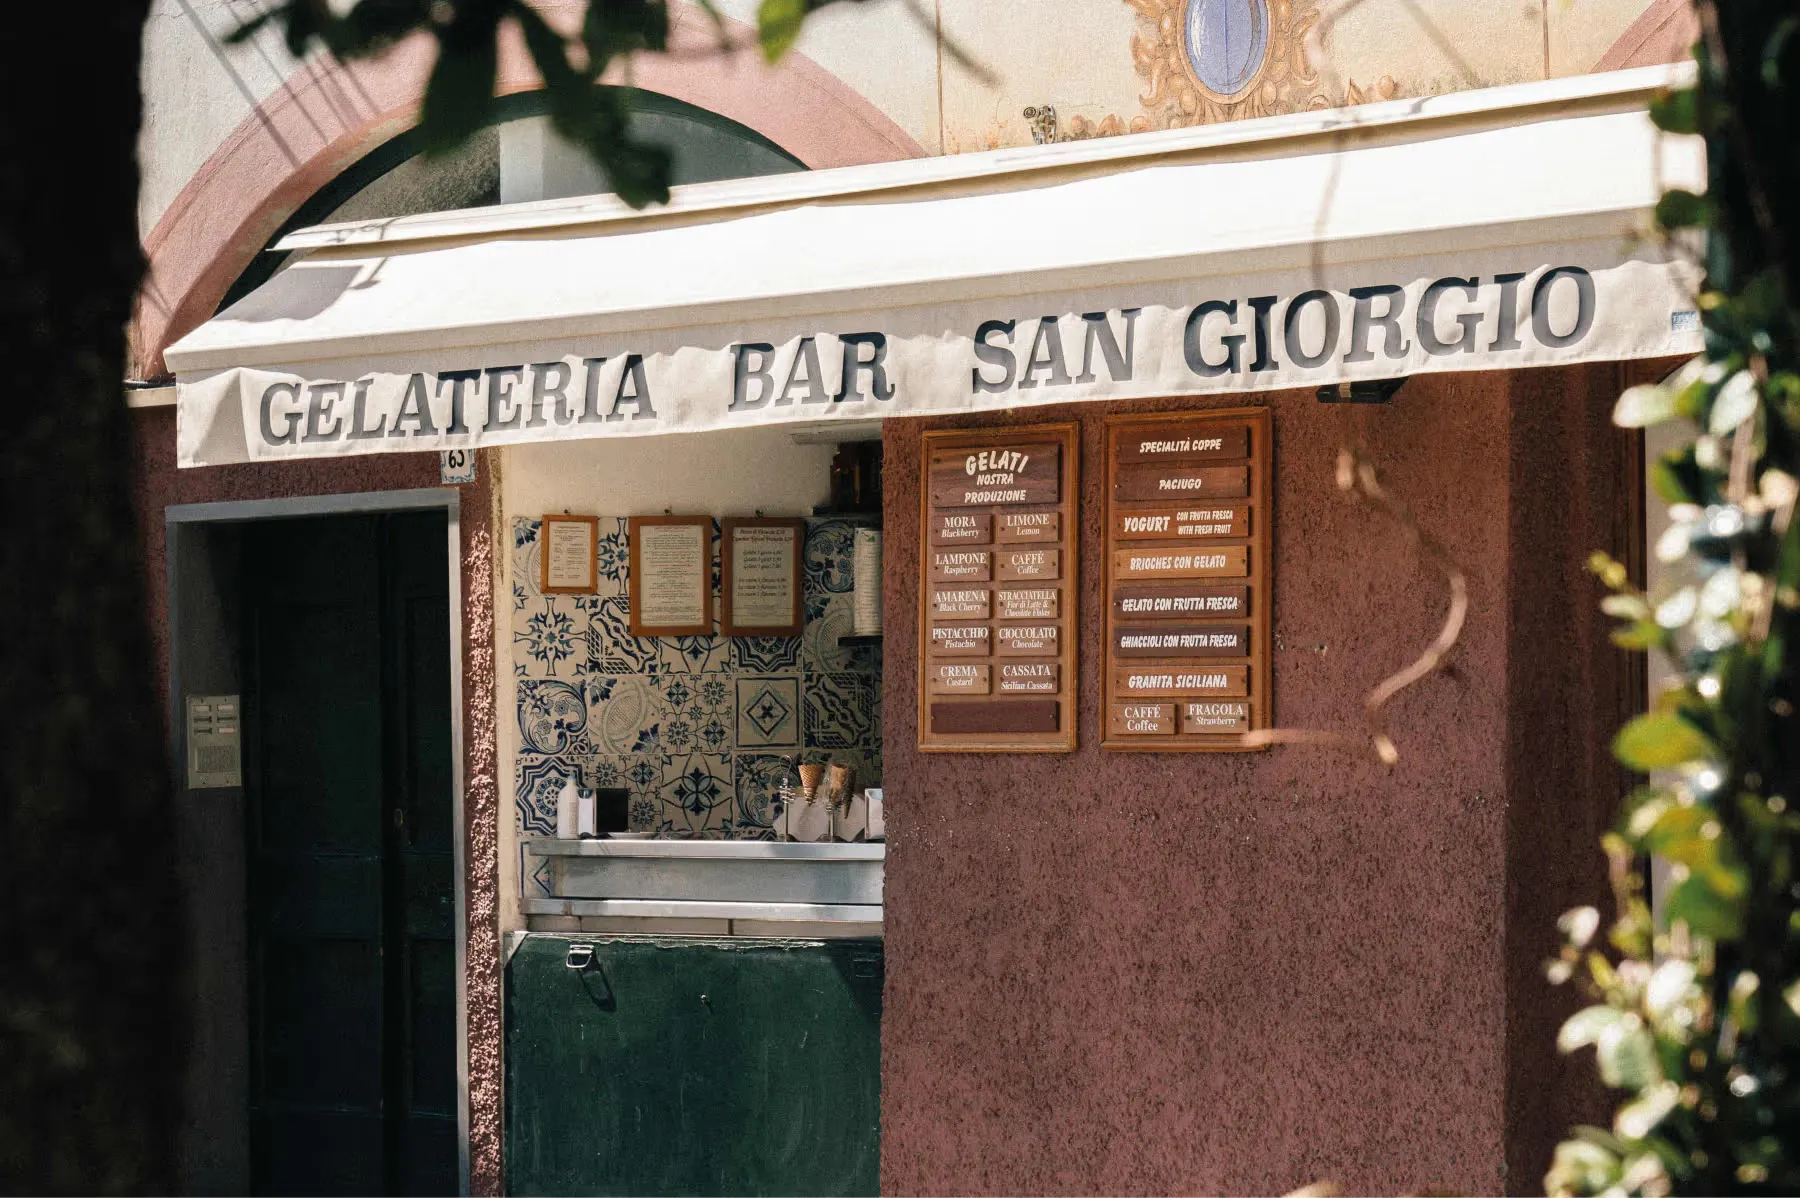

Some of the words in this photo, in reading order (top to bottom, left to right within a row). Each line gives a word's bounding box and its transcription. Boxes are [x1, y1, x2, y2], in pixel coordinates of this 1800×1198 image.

[260, 354, 656, 446] GELATERIA
[728, 331, 895, 413] BAR
[972, 308, 1142, 394] SAN
[1183, 266, 1596, 377] GIORGIO
[1139, 437, 1190, 453] SPECIALITÀ
[1192, 438, 1222, 451] COPPE
[965, 450, 1029, 476] GELATI
[976, 473, 1014, 486] NOSTRA
[1159, 478, 1202, 490] PACIUGO
[964, 489, 1026, 503] PRODUZIONE
[1007, 514, 1049, 527] LIMONE
[1176, 511, 1189, 521] CON
[1190, 510, 1211, 521] FRUTTA
[1212, 509, 1233, 520] FRESCA
[944, 516, 976, 527] MORA
[1124, 515, 1171, 532] YOGURT
[941, 527, 980, 538] Blackberry
[1016, 527, 1040, 536] Lemon
[1178, 525, 1194, 535] WITH
[1194, 524, 1213, 535] FRESH
[1213, 523, 1232, 534] FRUIT
[935, 552, 987, 565] LAMPONE
[1130, 556, 1171, 571] BRIOCHES
[1174, 556, 1191, 569] CON
[1193, 555, 1226, 568] GELATO
[943, 565, 978, 576] Raspberry
[1017, 565, 1040, 575] Coffee
[935, 591, 986, 602] AMARENA
[998, 591, 1056, 601] STRACCIATELLA
[939, 602, 957, 611] Black
[958, 602, 981, 614] Cherry
[1122, 598, 1152, 612] GELATO
[1154, 598, 1171, 611] CON
[1173, 597, 1204, 611] FRUTTA
[1206, 597, 1238, 610] FRESCA
[932, 627, 988, 640] PISTACCHIO
[999, 627, 1056, 639] CIOCCOLATO
[944, 640, 976, 649] Pistachio
[1012, 639, 1043, 649] Chocolate
[1120, 635, 1162, 648] GHIACCIOLI
[1163, 635, 1179, 647] CON
[1180, 635, 1208, 647] FRUTTA
[1209, 634, 1237, 647] FRESCA
[940, 666, 978, 677] CREMA
[1003, 664, 1051, 677] CASSATA
[946, 677, 973, 686] Custard
[1026, 680, 1053, 690] Cassata
[1128, 675, 1172, 689] GRANITA
[1175, 674, 1227, 688] SICILIANA
[1189, 703, 1243, 715] FRAGOLA
[1127, 719, 1159, 731] Coffee
[1195, 716, 1237, 727] Strawberry
